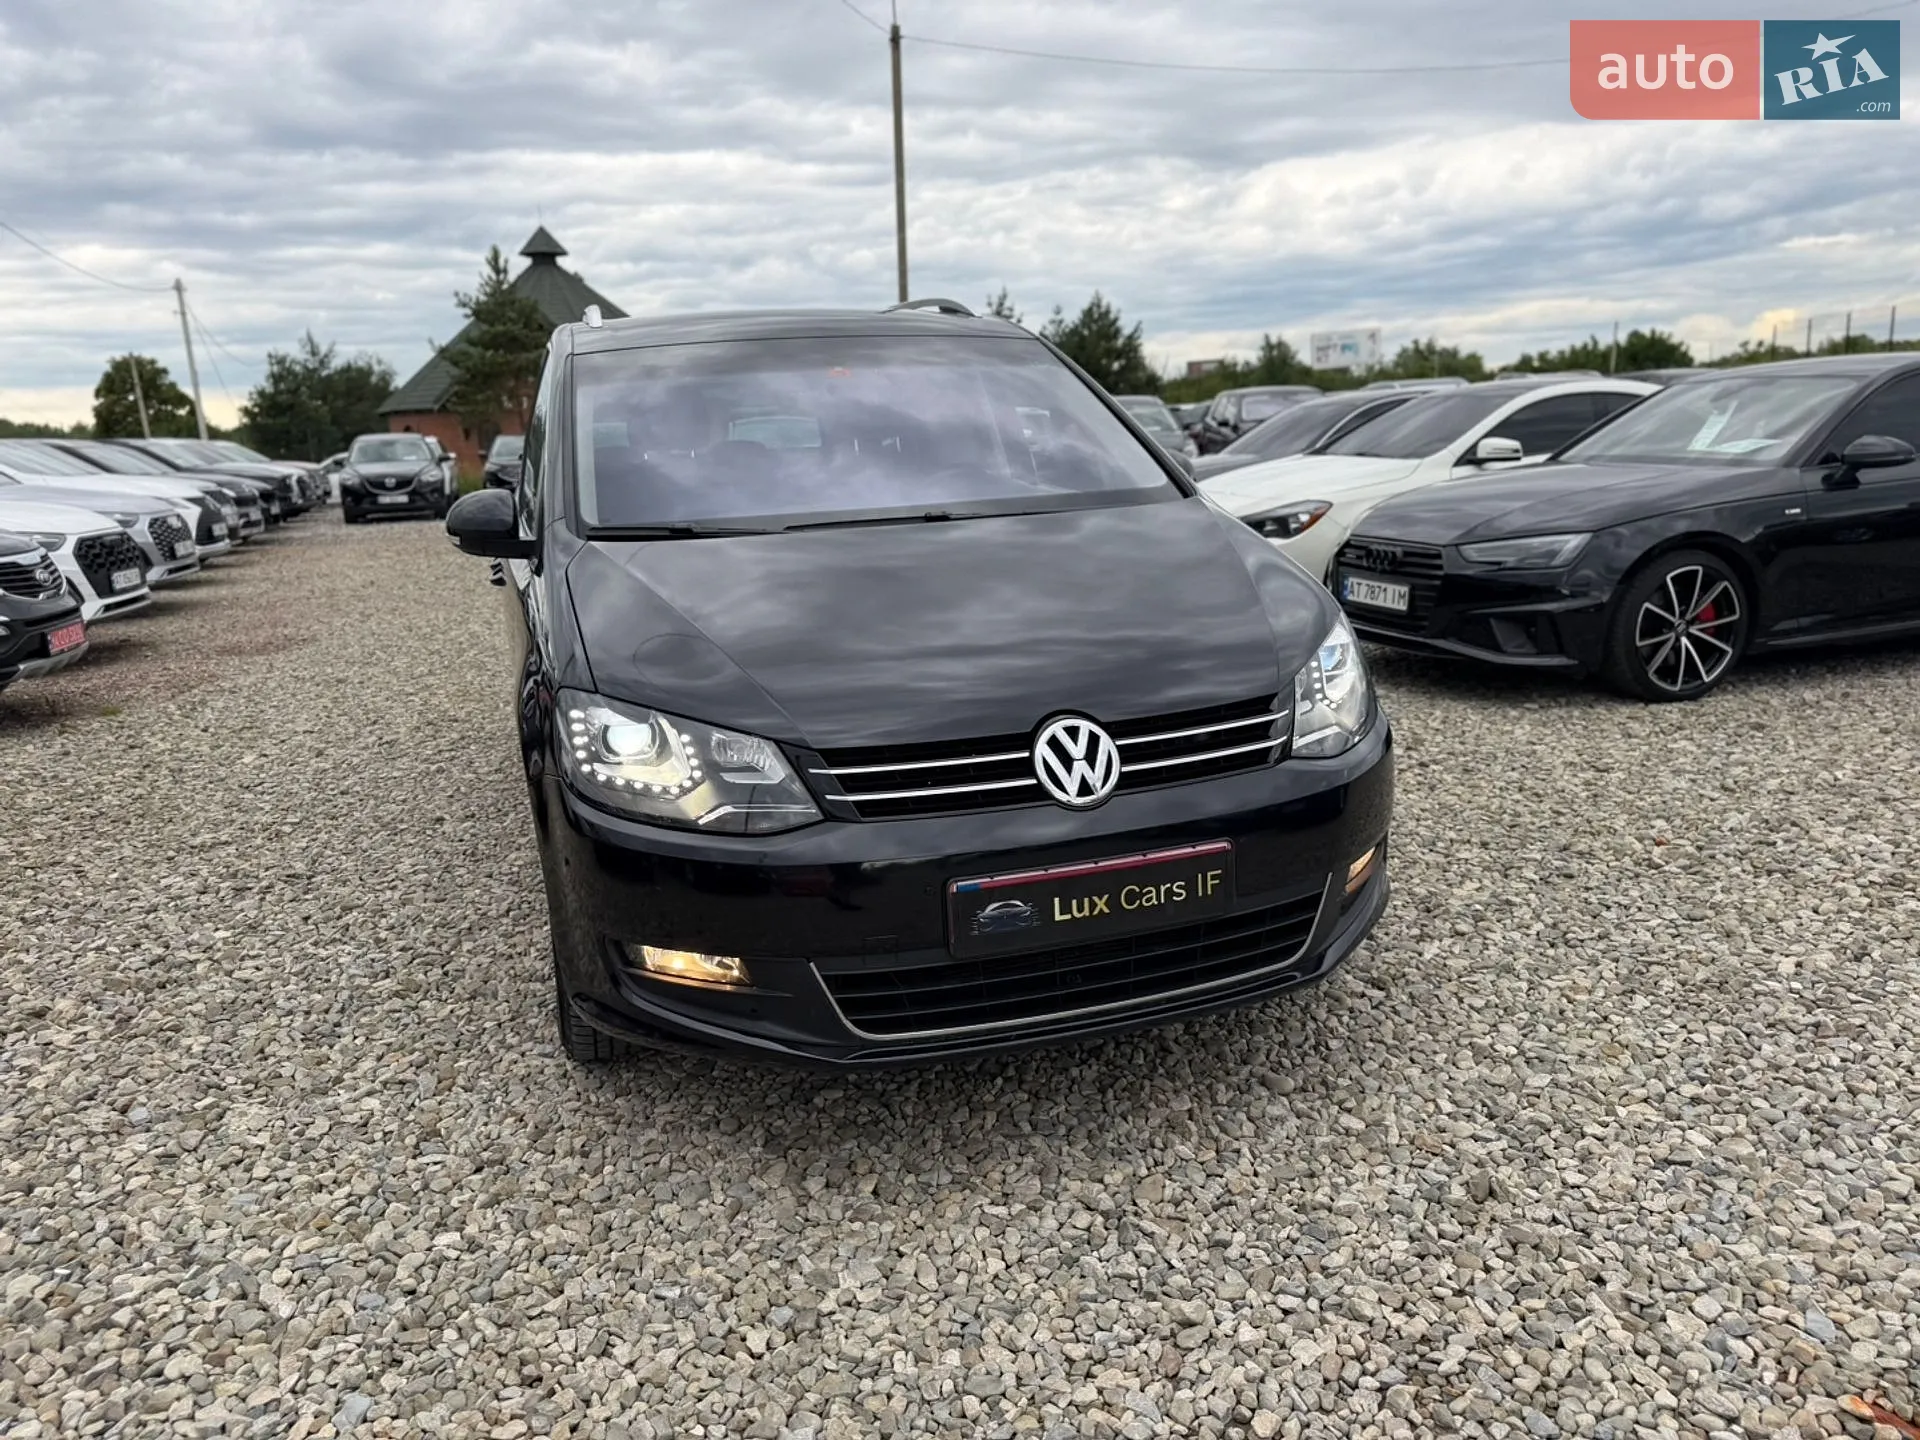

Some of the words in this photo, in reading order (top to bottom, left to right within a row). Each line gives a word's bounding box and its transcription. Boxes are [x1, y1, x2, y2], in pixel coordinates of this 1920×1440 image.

[1348, 580, 1362, 599] AT
[1364, 584, 1388, 603] 7871
[1053, 894, 1111, 922] Lux
[1120, 879, 1187, 911] Cars
[1197, 869, 1222, 897] IF
